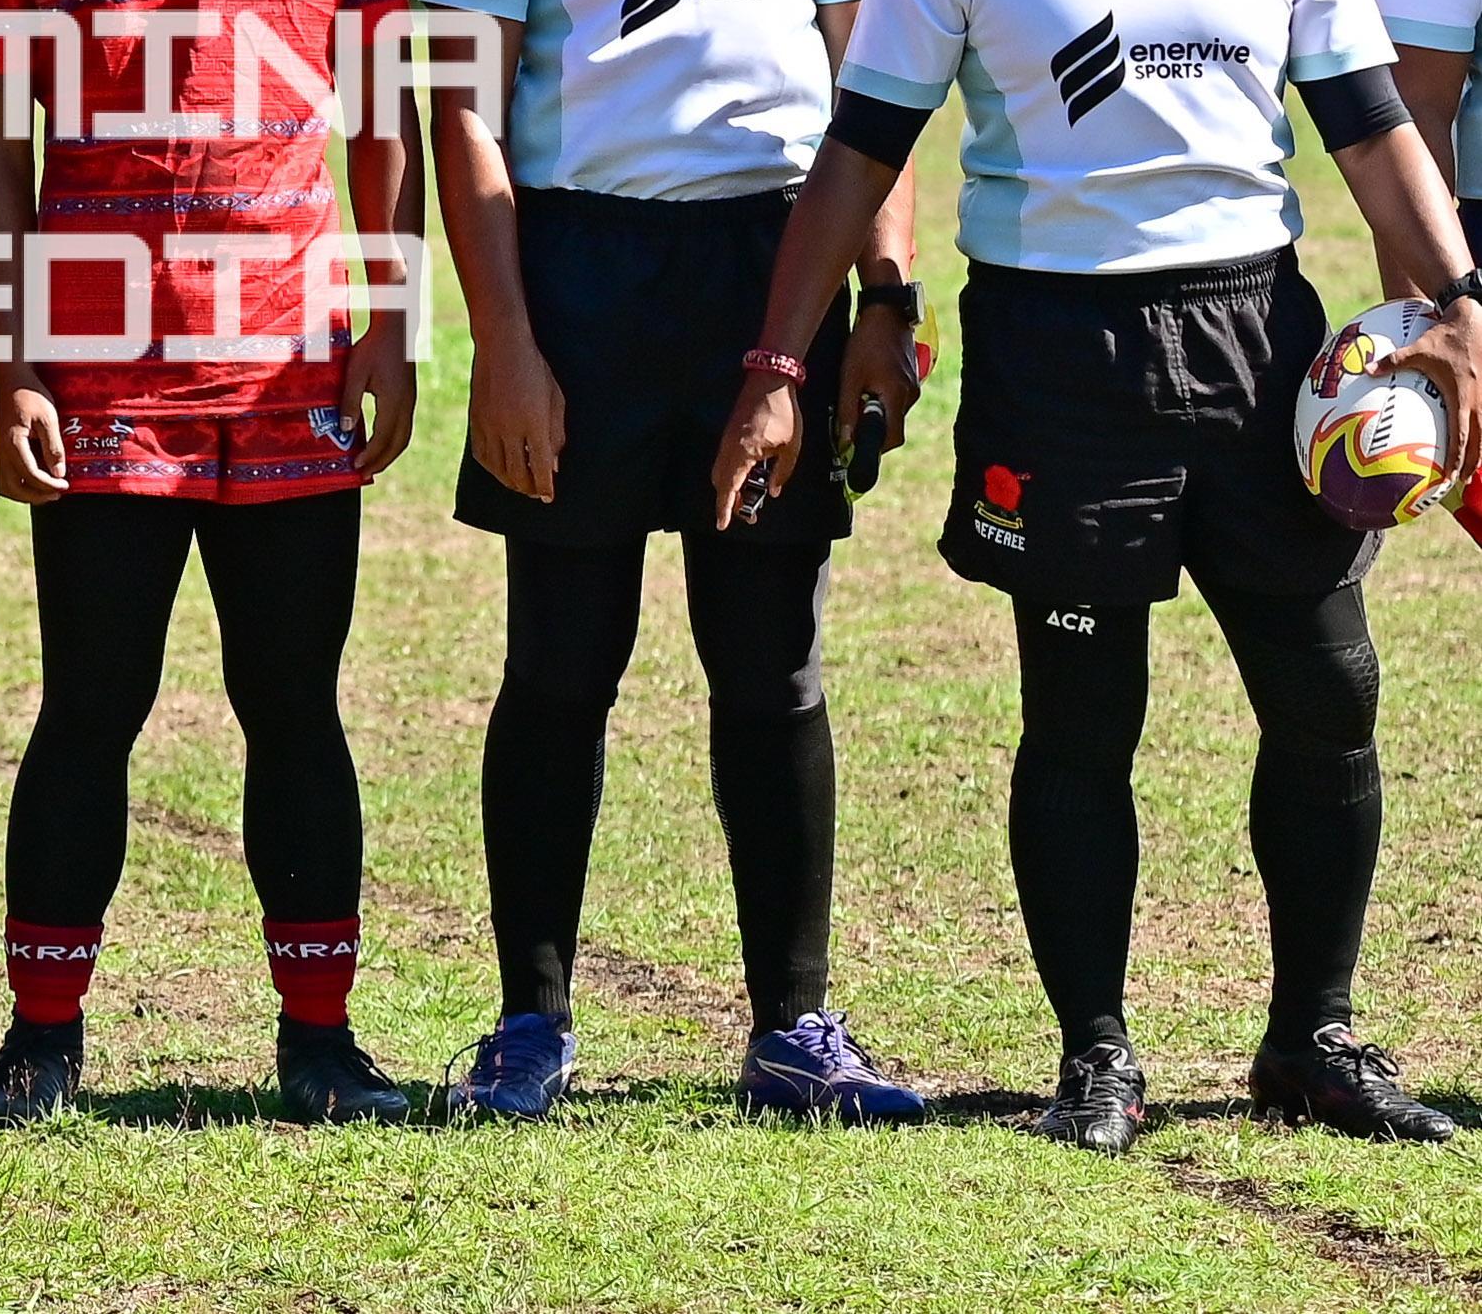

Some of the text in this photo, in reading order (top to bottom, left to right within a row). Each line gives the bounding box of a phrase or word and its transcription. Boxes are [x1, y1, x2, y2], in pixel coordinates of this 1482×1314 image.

[1129, 38, 1250, 64] enervive
[1135, 62, 1203, 79] SPORTS
[974, 519, 1026, 552] REFEREE
[1046, 610, 1096, 635] ACR
